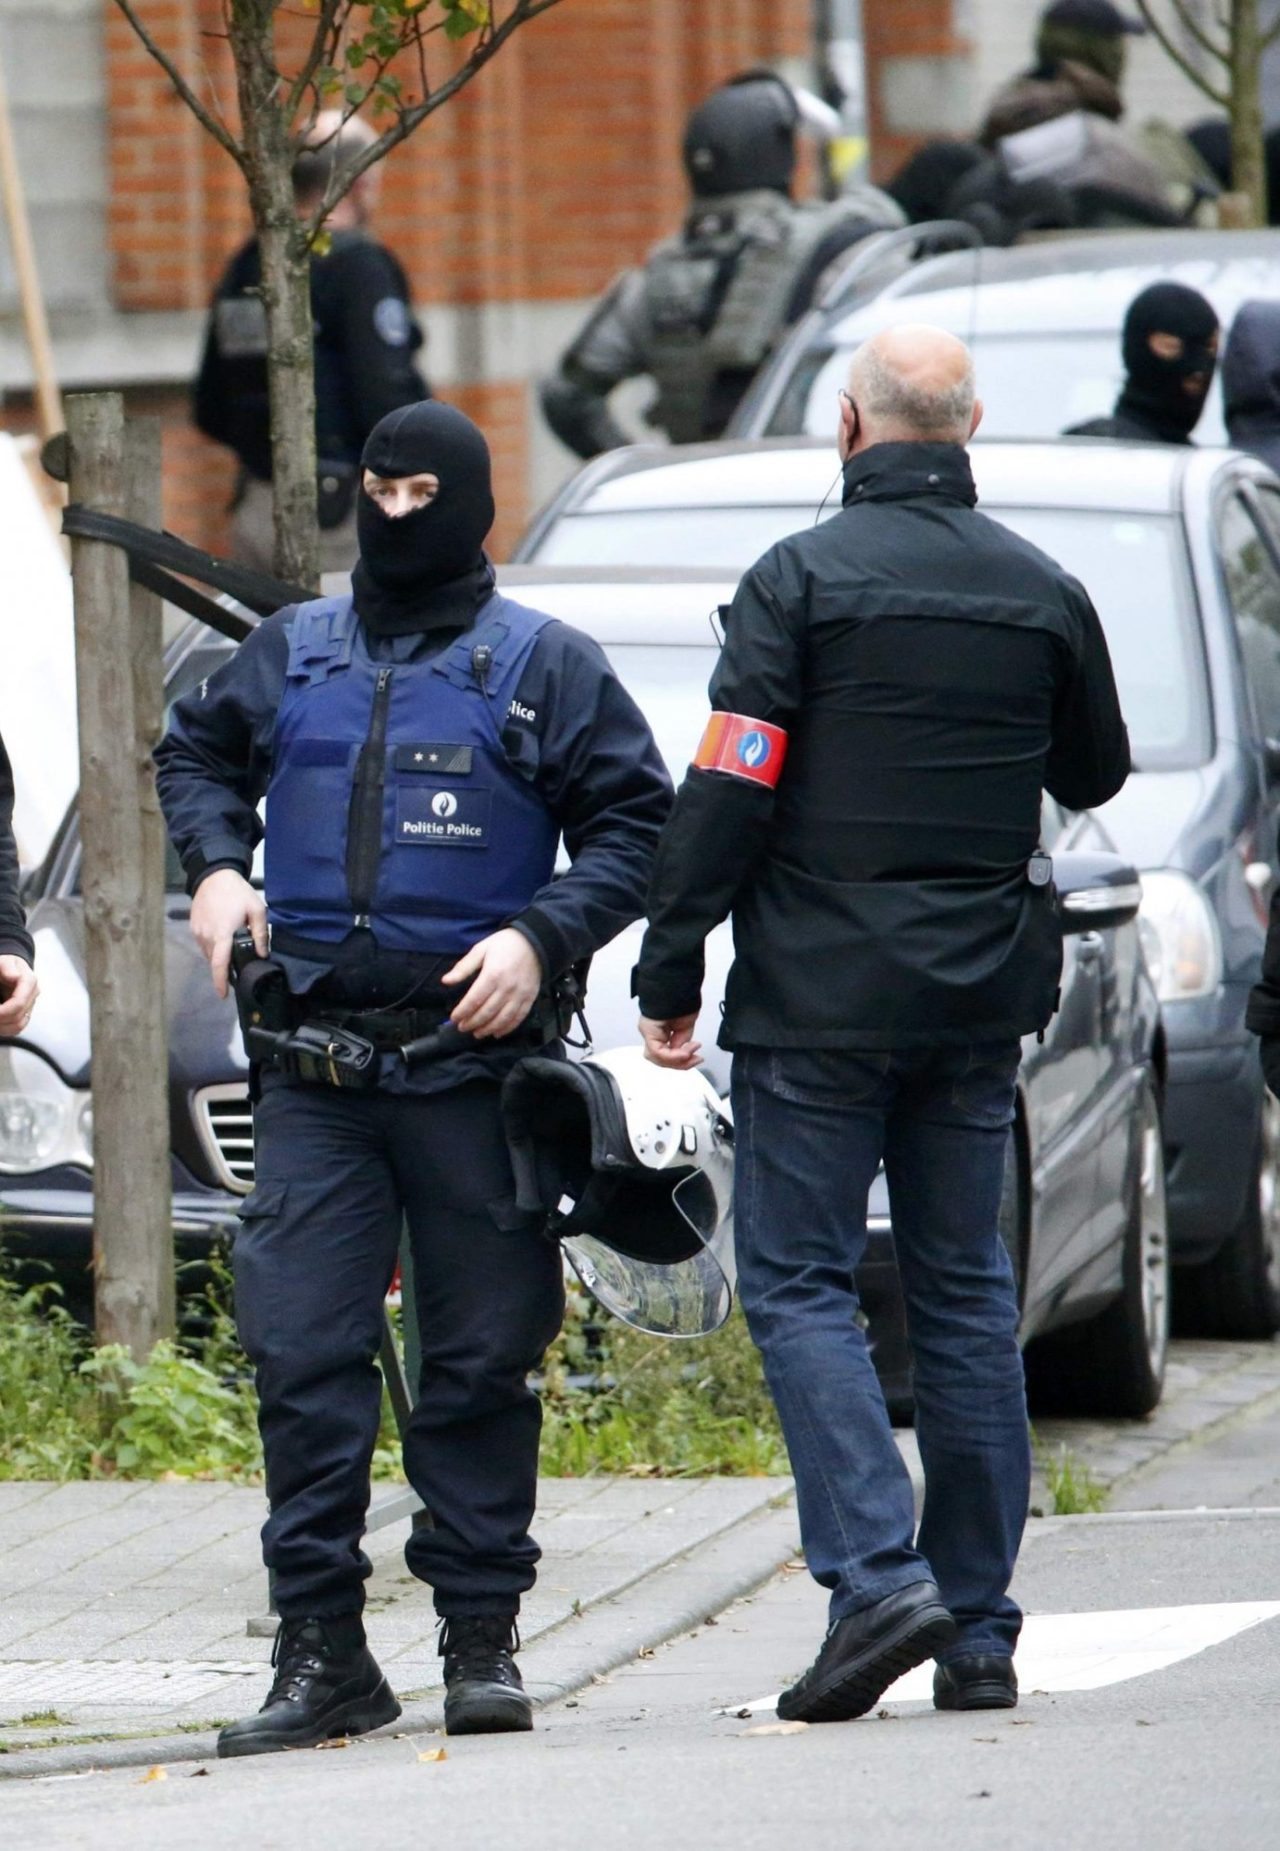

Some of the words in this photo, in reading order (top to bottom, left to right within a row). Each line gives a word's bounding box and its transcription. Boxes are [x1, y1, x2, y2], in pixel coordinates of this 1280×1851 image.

[507, 700, 536, 721] lice
[403, 821, 444, 834] Politie
[447, 823, 482, 836] Police
